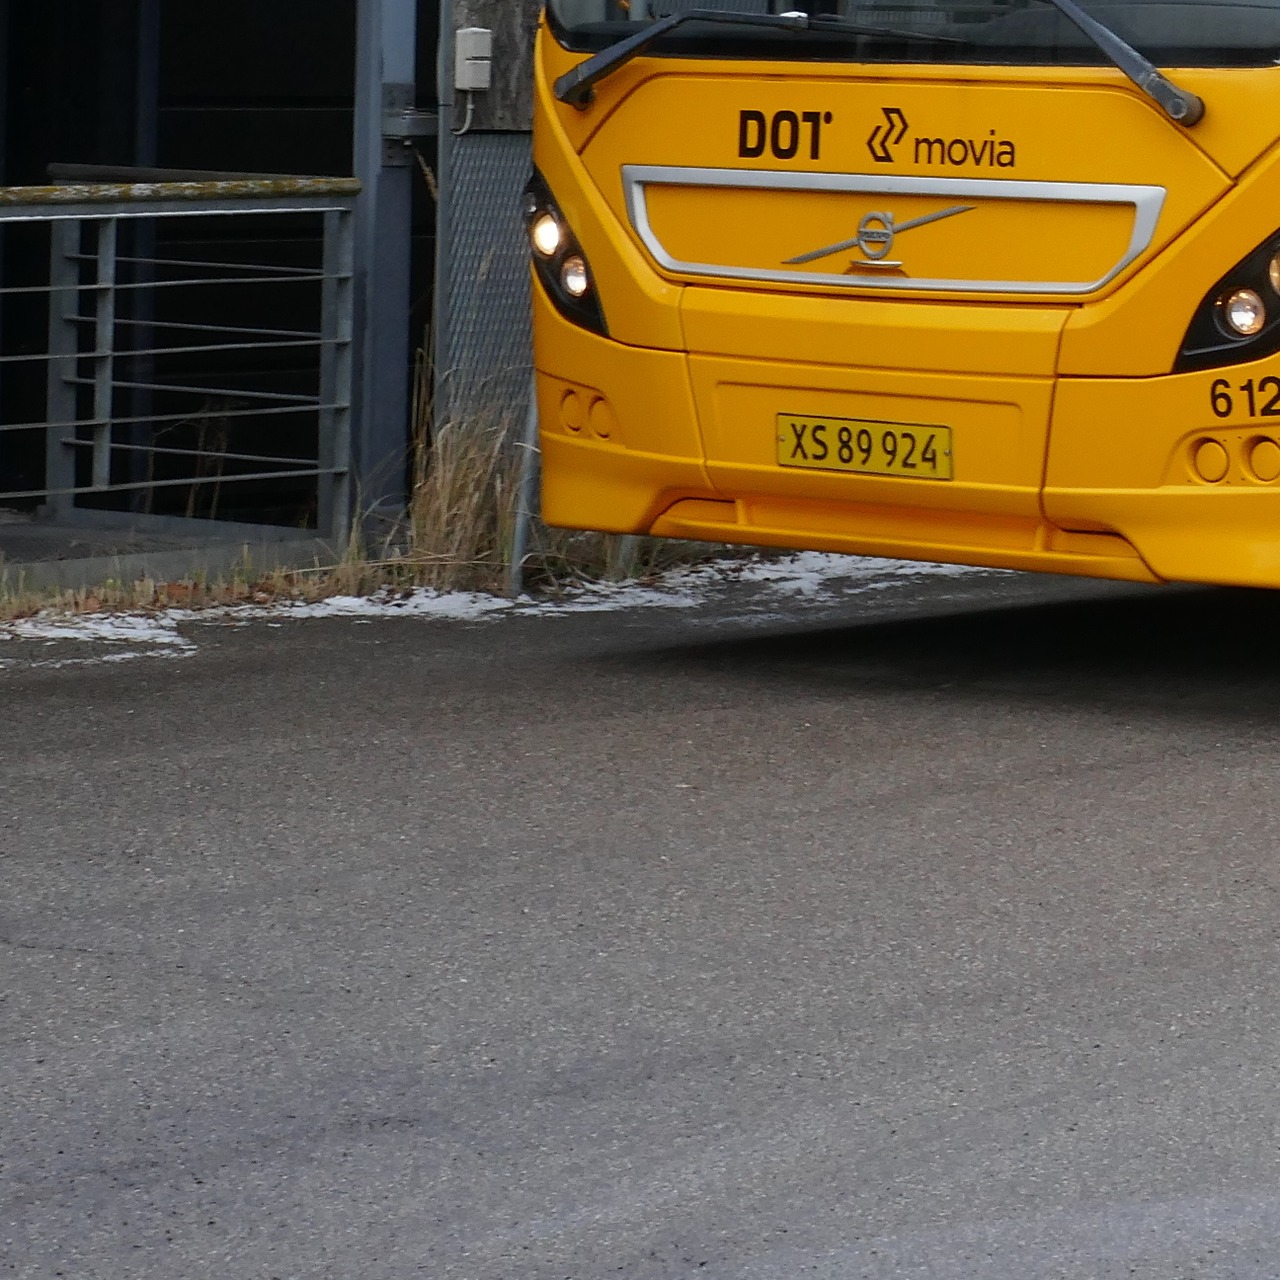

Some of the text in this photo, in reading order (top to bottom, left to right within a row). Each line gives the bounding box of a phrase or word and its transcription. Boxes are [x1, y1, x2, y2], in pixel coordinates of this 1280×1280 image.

[914, 129, 1016, 167] movia
[790, 423, 936, 470] XS 89 924
